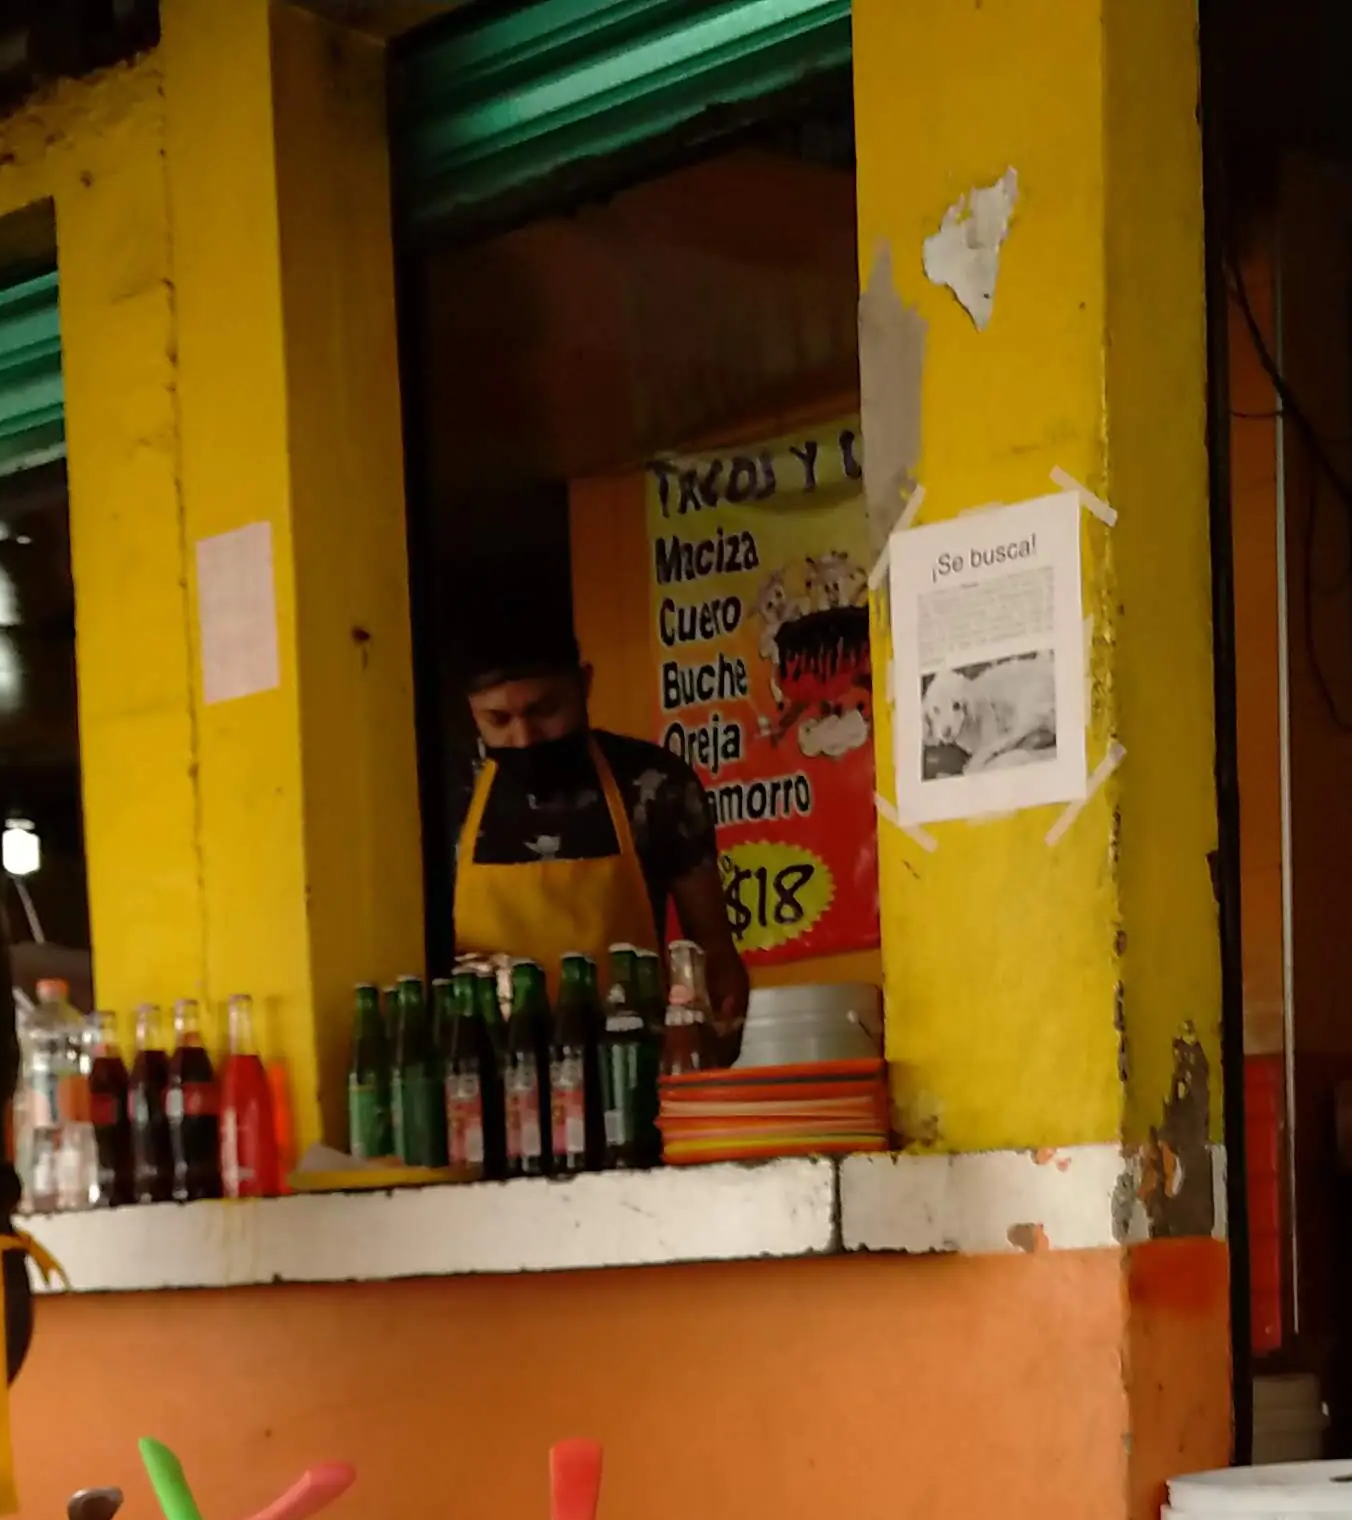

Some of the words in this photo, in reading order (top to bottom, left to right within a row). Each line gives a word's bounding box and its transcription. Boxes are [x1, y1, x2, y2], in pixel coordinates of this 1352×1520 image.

[790, 441, 818, 491] Y
[656, 530, 759, 585] Maciza
[970, 532, 1036, 568] busca!
[660, 596, 742, 647] Cuero
[662, 656, 748, 710] Buche
[664, 714, 741, 774] Oreja
[725, 864, 816, 941] $18
